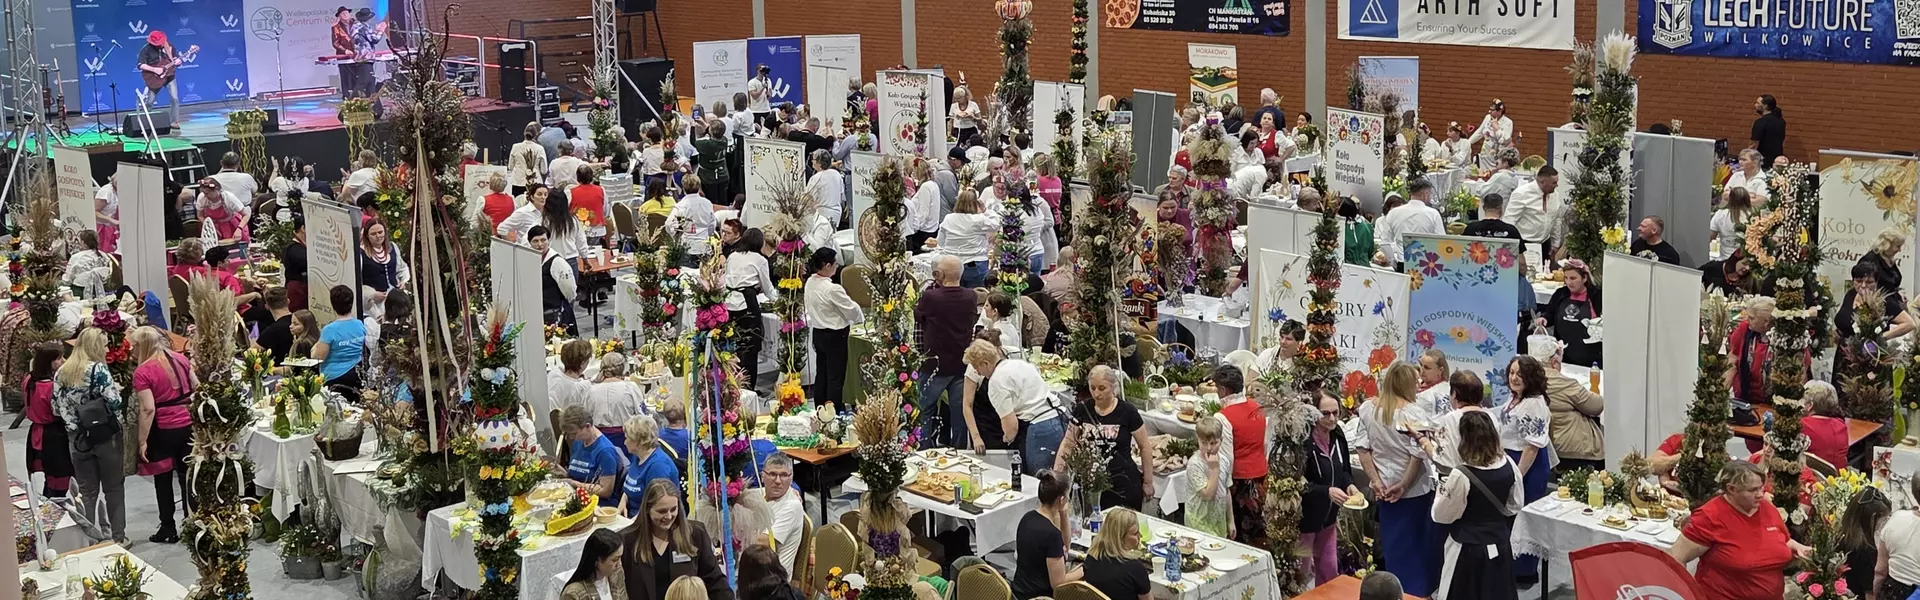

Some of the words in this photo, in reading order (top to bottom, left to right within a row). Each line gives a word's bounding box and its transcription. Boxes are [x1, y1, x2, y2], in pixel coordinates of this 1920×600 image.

[286, 17, 322, 26] Centrum
[1704, 0, 1768, 28] LECH
[1775, 0, 1873, 32] FUTURE
[1416, 22, 1455, 35] Ensuring
[1457, 24, 1478, 34] Your
[1480, 25, 1517, 36] Success
[1704, 32, 1871, 49] WILKOWICE
[1562, 141, 1580, 149] Koło
[1336, 149, 1350, 161] Koło
[1335, 161, 1366, 175] Gospodyń
[1335, 173, 1366, 187] Wiejskich
[1823, 217, 1866, 236] Koło
[1423, 310, 1475, 323] GOSPODYŃ
[1476, 315, 1514, 353] WIEJSKICH
